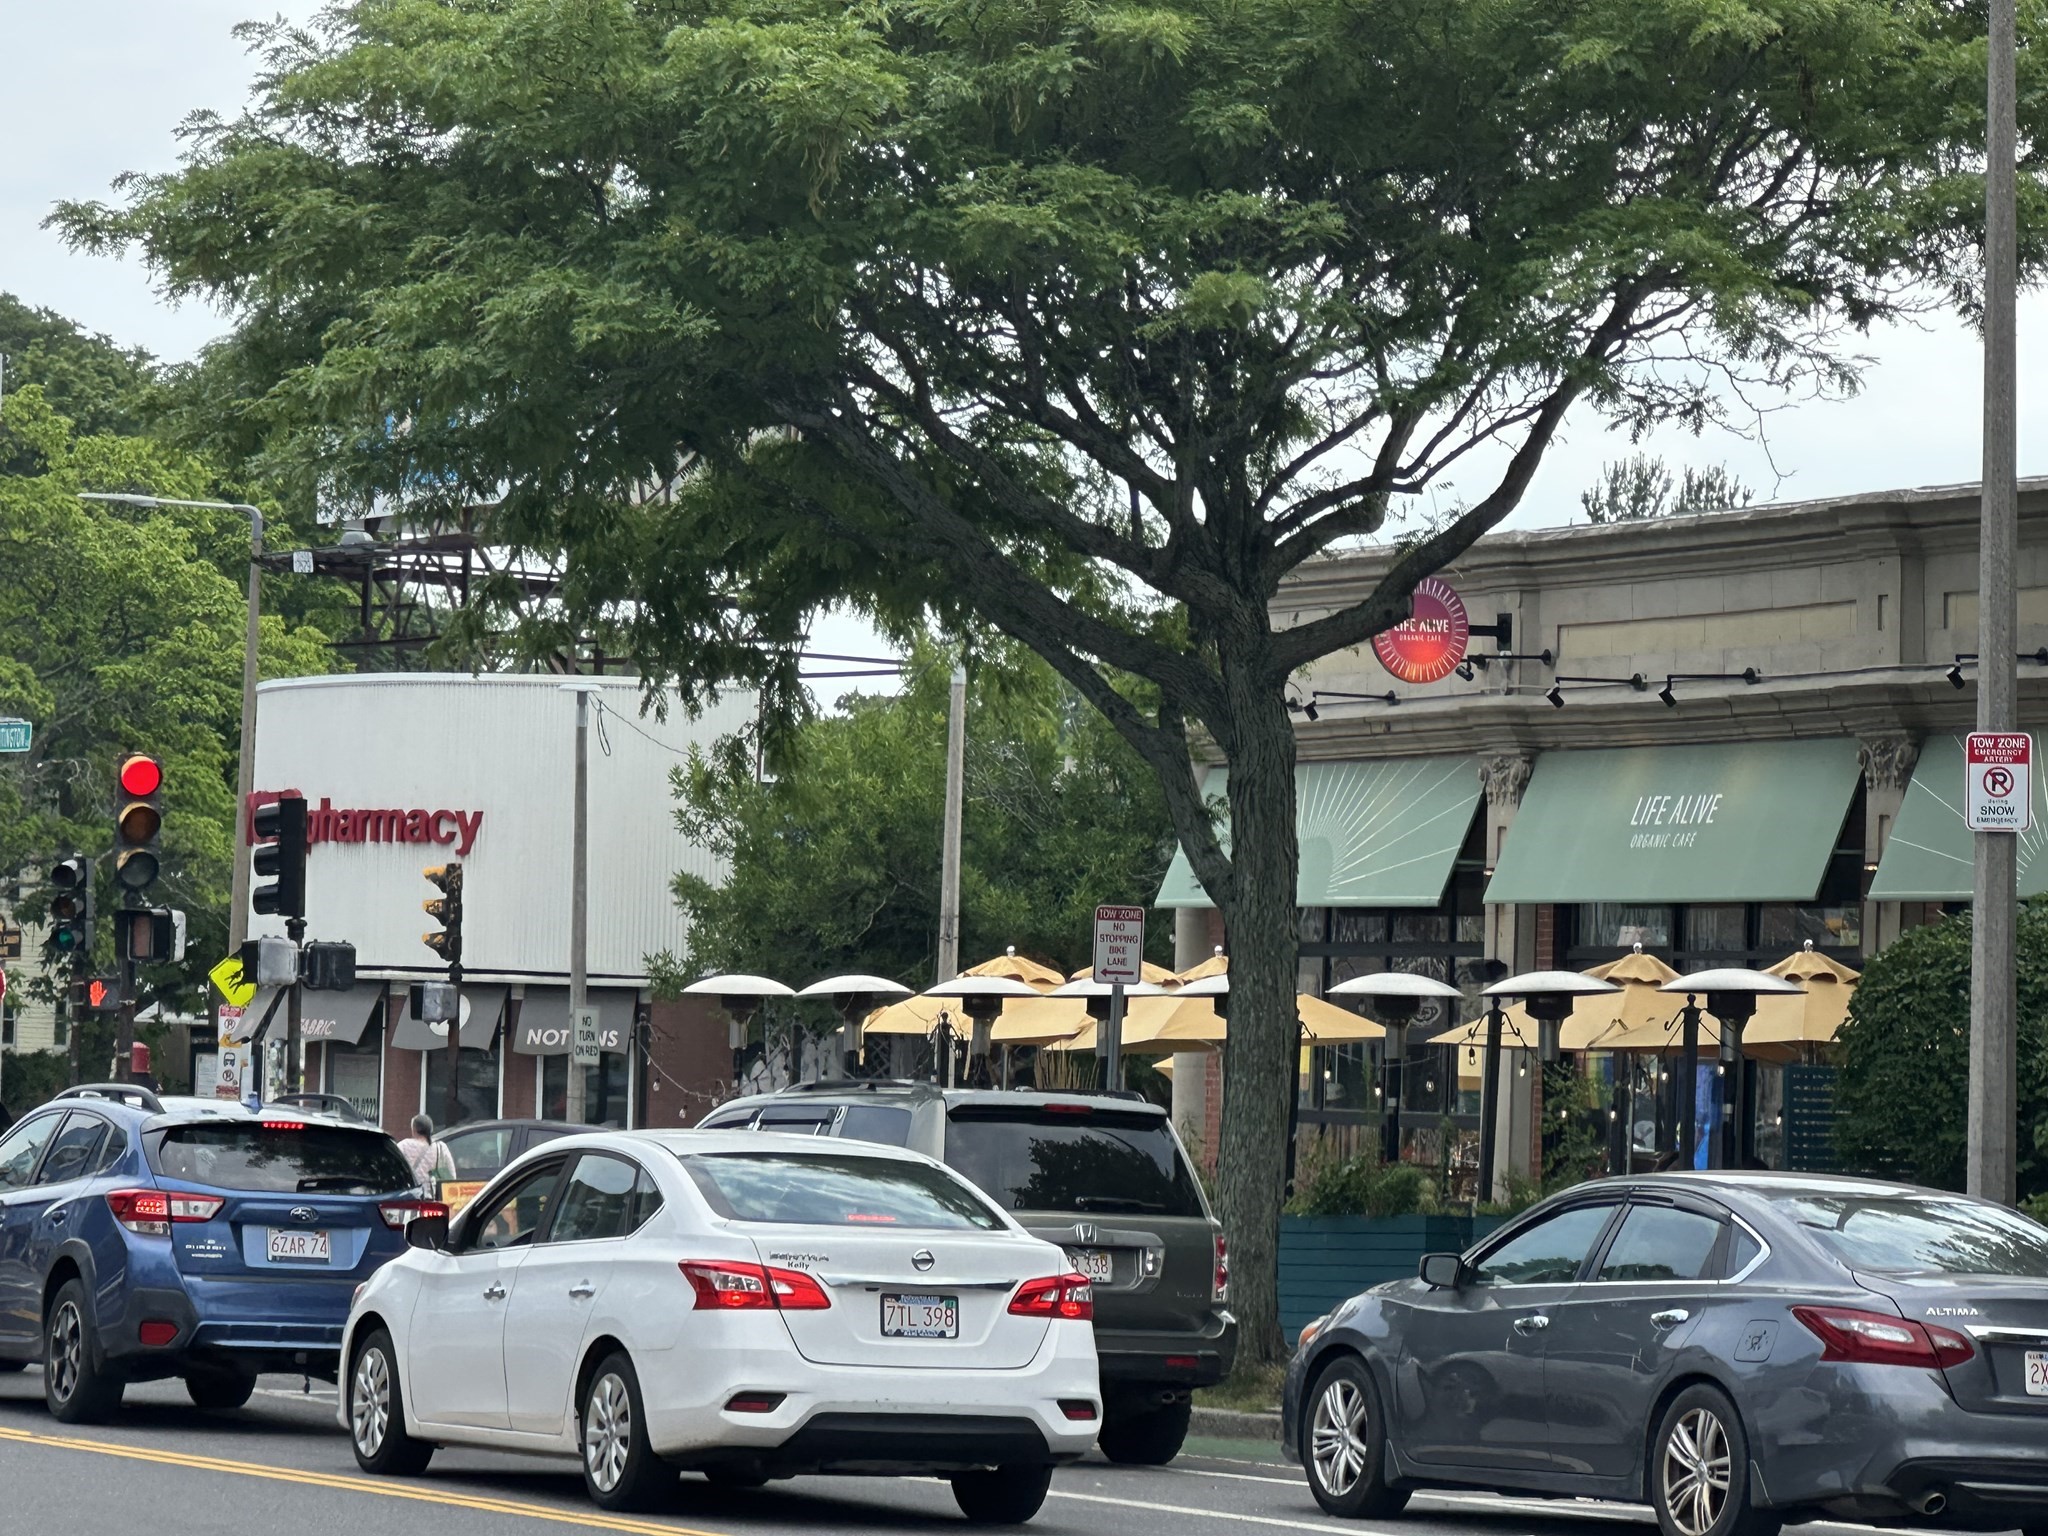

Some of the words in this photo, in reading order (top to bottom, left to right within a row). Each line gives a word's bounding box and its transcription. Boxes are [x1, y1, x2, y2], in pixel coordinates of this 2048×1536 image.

[1419, 619, 1449, 632] ALIVE
[1971, 737, 1994, 748] TOW
[1997, 738, 2026, 748] ZONE
[1983, 755, 2015, 763] ARTERY
[1630, 795, 1671, 826] LIFE
[1668, 793, 1723, 825] ALIVE
[1980, 805, 2015, 816] SNOW
[1630, 833, 1671, 849] ORGANIC
[1099, 908, 1117, 919] TOW
[1119, 909, 1142, 920] ZONE
[1113, 922, 1125, 932] NO
[1099, 933, 1139, 944] STOPPING
[1107, 957, 1128, 967] LANE
[582, 1015, 592, 1027] NO
[579, 1030, 595, 1042] TURN
[575, 1045, 585, 1056] ON
[585, 1045, 598, 1057] RED
[271, 1236, 306, 1254] 6ZAR
[311, 1237, 327, 1255] 74
[787, 1261, 810, 1271] Kelly
[1084, 1256, 1109, 1275] 338
[886, 1305, 918, 1328] 7TL
[922, 1306, 954, 1328] 398
[1926, 1307, 1979, 1316] ALTIMA
